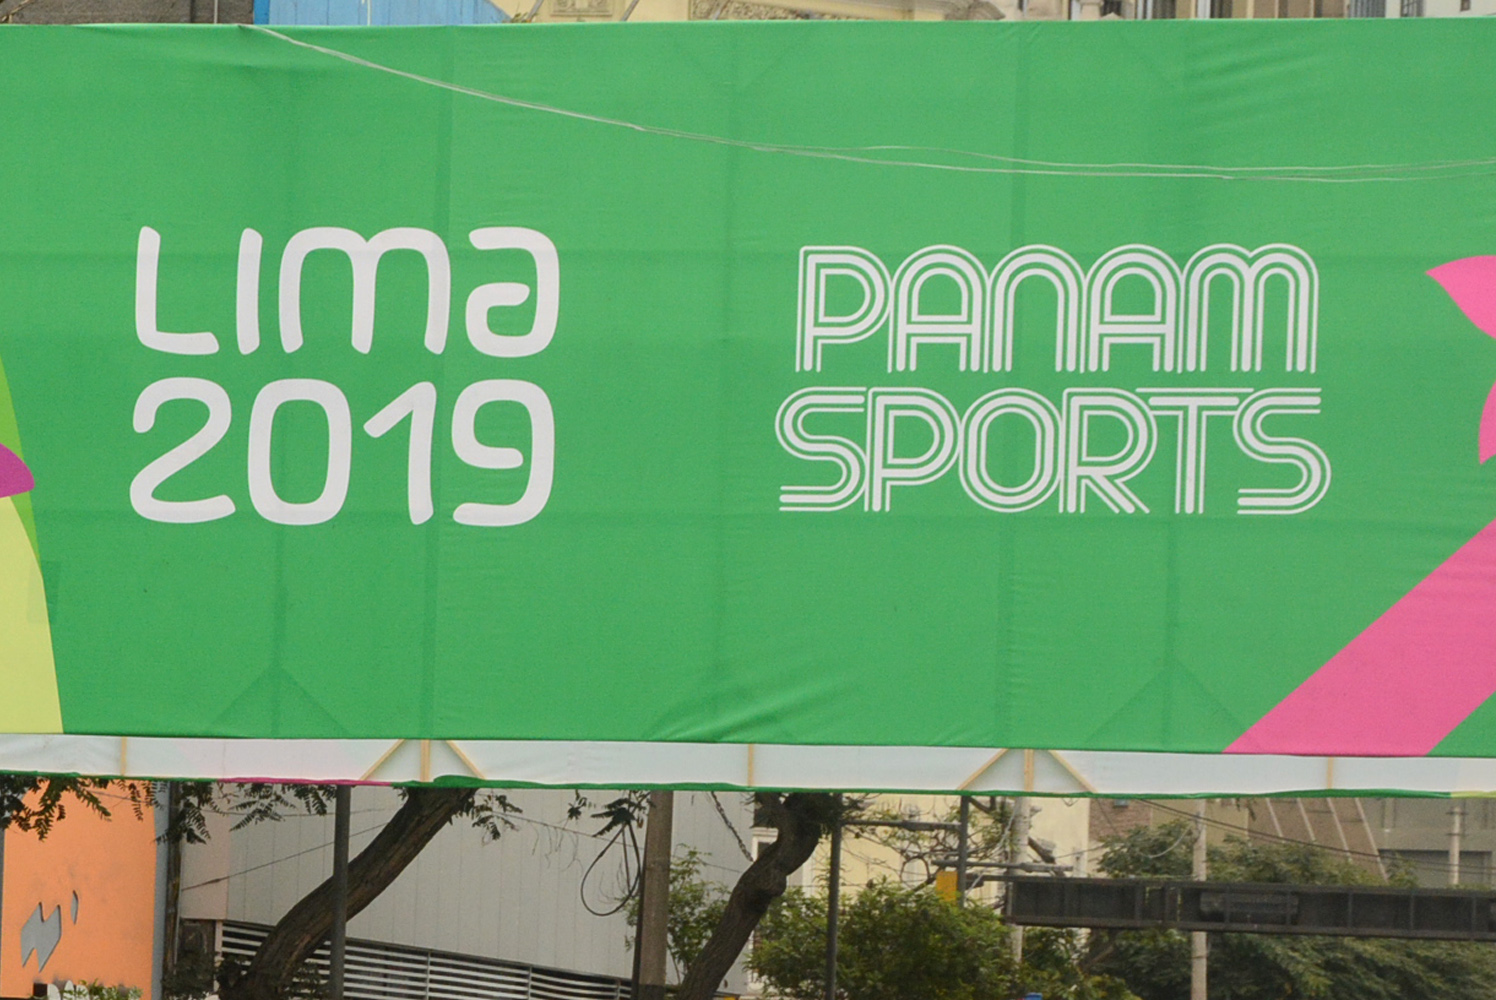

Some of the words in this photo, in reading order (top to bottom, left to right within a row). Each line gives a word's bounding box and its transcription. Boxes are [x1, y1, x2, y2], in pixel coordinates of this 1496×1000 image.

[795, 243, 1320, 373] PANAM
[129, 376, 555, 527] 2019
[774, 386, 1332, 515] SPORTS
